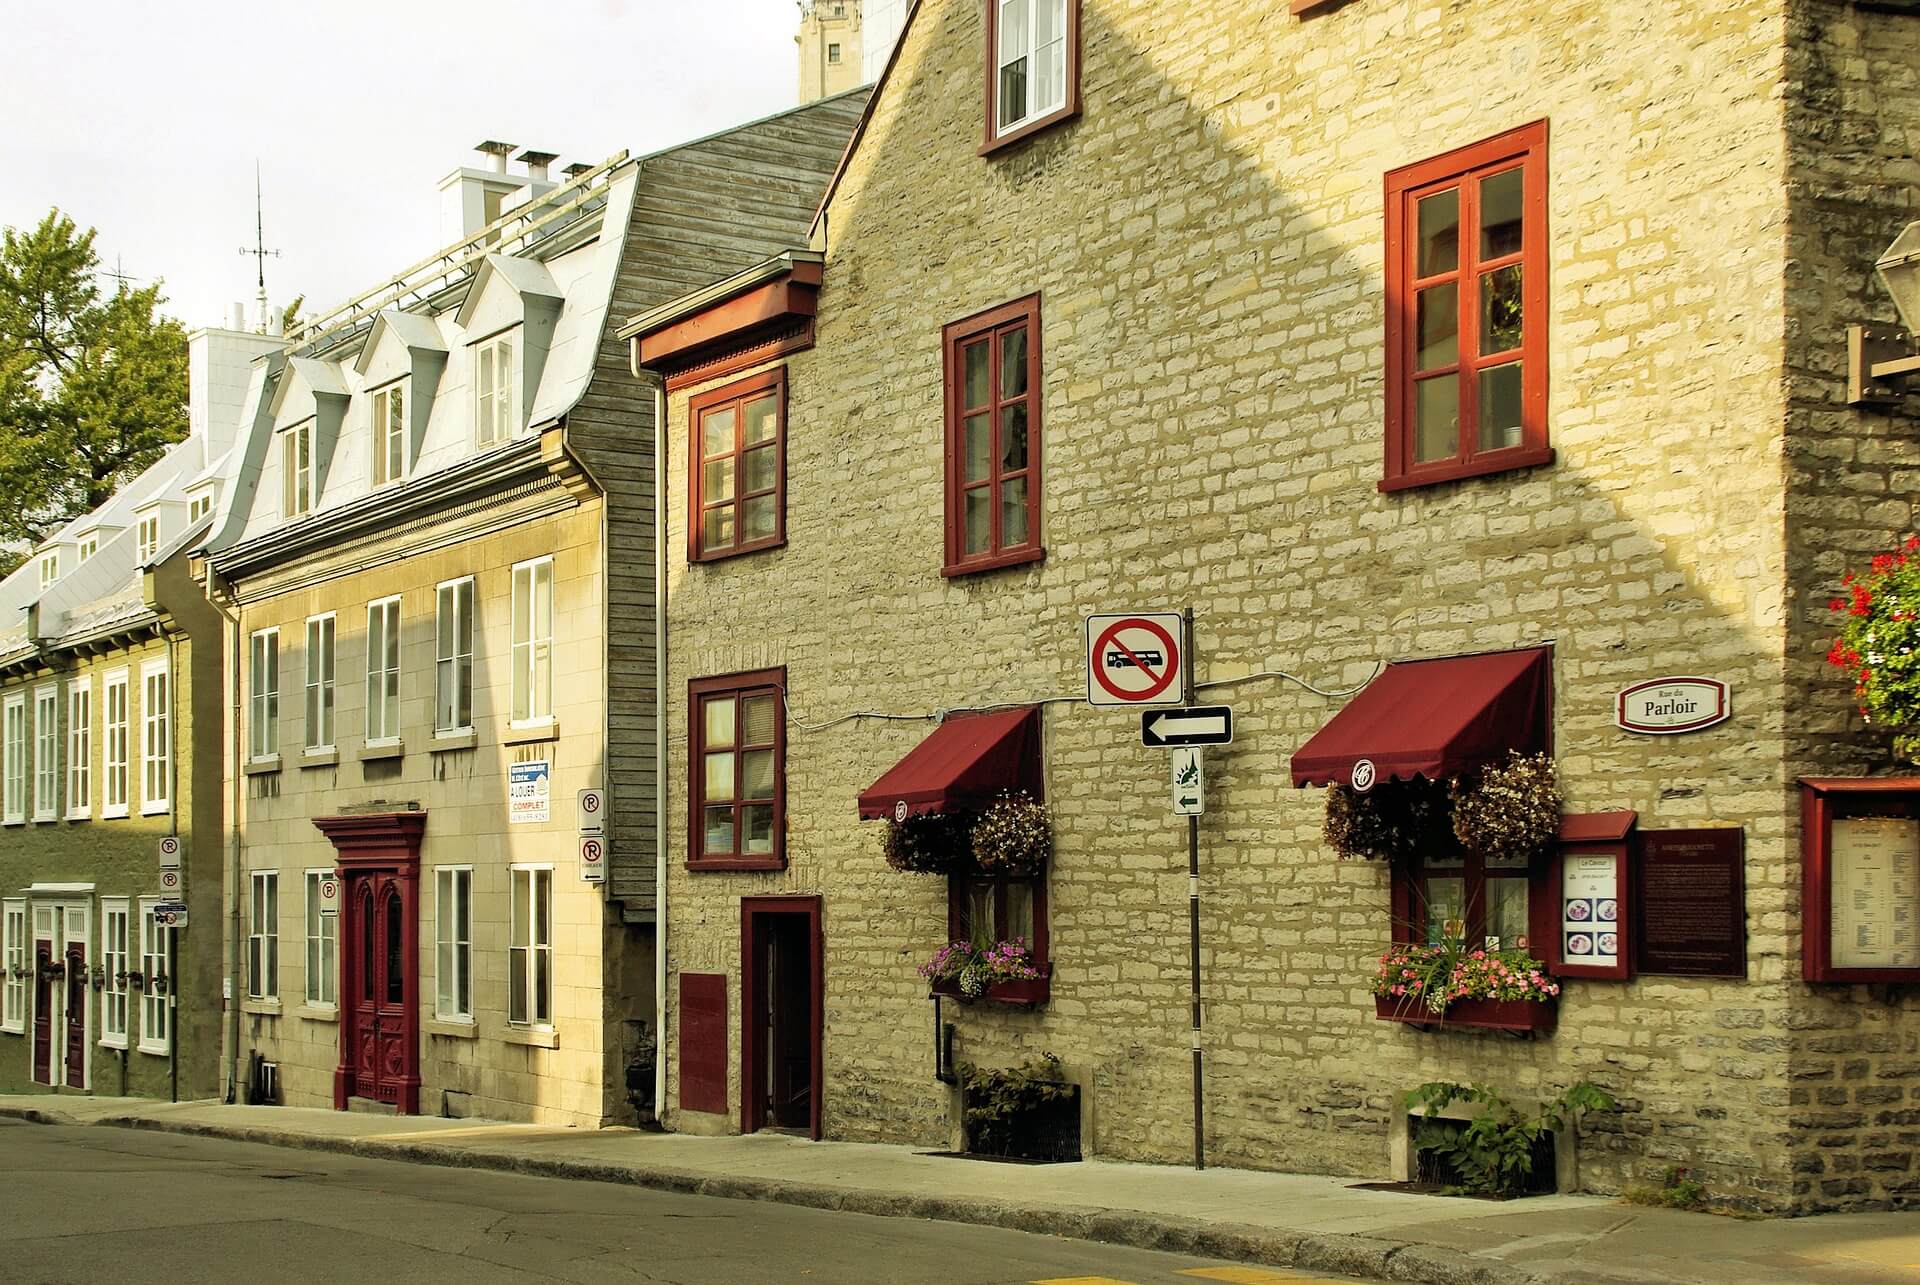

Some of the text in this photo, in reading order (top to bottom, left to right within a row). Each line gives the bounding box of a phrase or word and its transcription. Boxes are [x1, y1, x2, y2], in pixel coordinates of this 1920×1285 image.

[1658, 688, 1683, 698] Rue du
[1645, 698, 1698, 716] Parloir
[513, 801, 545, 810] COMPLET
